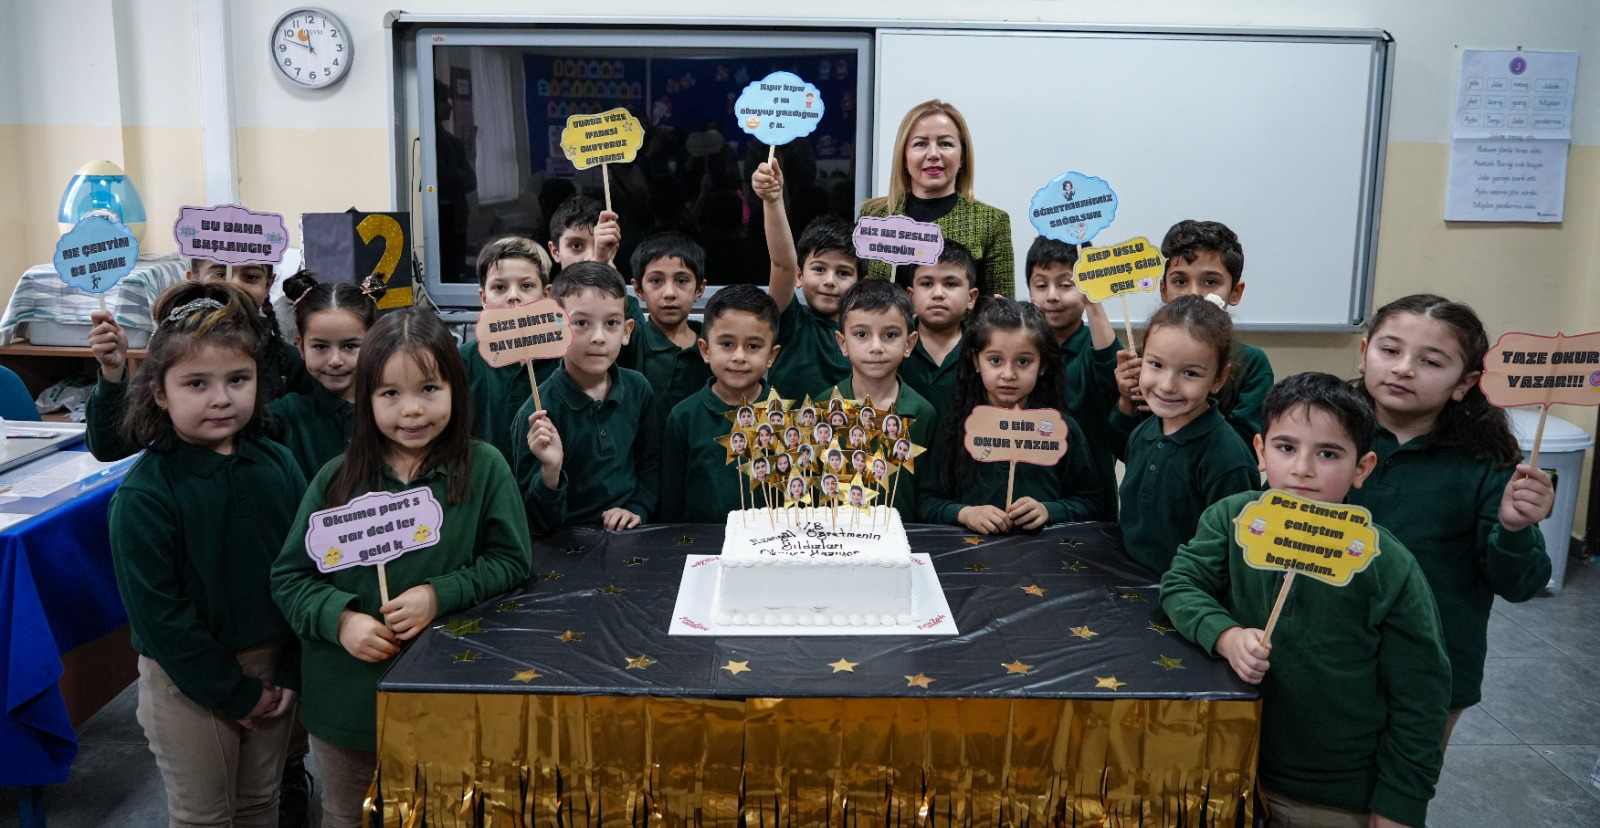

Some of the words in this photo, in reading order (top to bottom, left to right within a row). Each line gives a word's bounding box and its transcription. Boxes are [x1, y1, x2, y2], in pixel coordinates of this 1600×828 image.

[292, 19, 299, 28] 11
[305, 15, 315, 24] 12
[322, 19, 326, 28] 1
[284, 29, 294, 38] 10
[330, 29, 338, 38] 2
[279, 44, 287, 52] 9
[335, 44, 343, 52] 3
[284, 58, 292, 66] 8
[332, 58, 339, 66] 4
[1514, 62, 1522, 71] J
[294, 67, 301, 76] 7
[309, 71, 317, 80] 6
[324, 67, 331, 76] 5
[1033, 194, 1113, 218] ÖĞRETMENİMİZ
[1049, 210, 1102, 228] SAĞOLSUN
[201, 219, 221, 231] BU
[223, 221, 263, 235] DAHA
[860, 225, 879, 236] BİZ
[880, 228, 897, 239] NE
[898, 230, 939, 243] SESLER
[62, 247, 80, 260] NE
[81, 236, 130, 257] ÇEKTİN
[192, 238, 272, 256] BAŞLANGIÇ
[869, 242, 916, 256] GÖRDÜK
[1086, 249, 1111, 263] HEP
[1112, 242, 1145, 257] USLU
[70, 265, 87, 278] BE
[89, 256, 127, 274] ANNE
[356, 214, 414, 310] 2
[1078, 263, 1133, 282] DURMUŞ
[1134, 255, 1162, 270] GİBİ
[1110, 279, 1135, 293] ÇEK
[488, 319, 516, 333] BİZE
[518, 312, 556, 329] DİKTE
[488, 330, 564, 353] DAYANMAZ
[1501, 351, 1548, 365] TAZE
[1550, 350, 1600, 365] OKUR
[1507, 375, 1585, 389] YAZAR!!!
[999, 420, 1009, 431] O
[1011, 420, 1036, 432] BİR
[973, 436, 1011, 449] OKUR
[1014, 439, 1060, 451] YAZAR
[322, 507, 377, 528] Okuma
[378, 498, 411, 516] part
[412, 496, 420, 507] s
[1271, 495, 1298, 509] Pes
[1300, 503, 1348, 521] etmed
[1349, 514, 1369, 527] m,
[338, 531, 364, 544] var
[366, 521, 395, 538] ded
[396, 517, 416, 530] ler
[1284, 519, 1345, 540] çalıştım
[358, 541, 391, 561] geld
[393, 539, 404, 551] k
[1273, 536, 1344, 559] okumaya
[1265, 552, 1336, 577] başladım.
